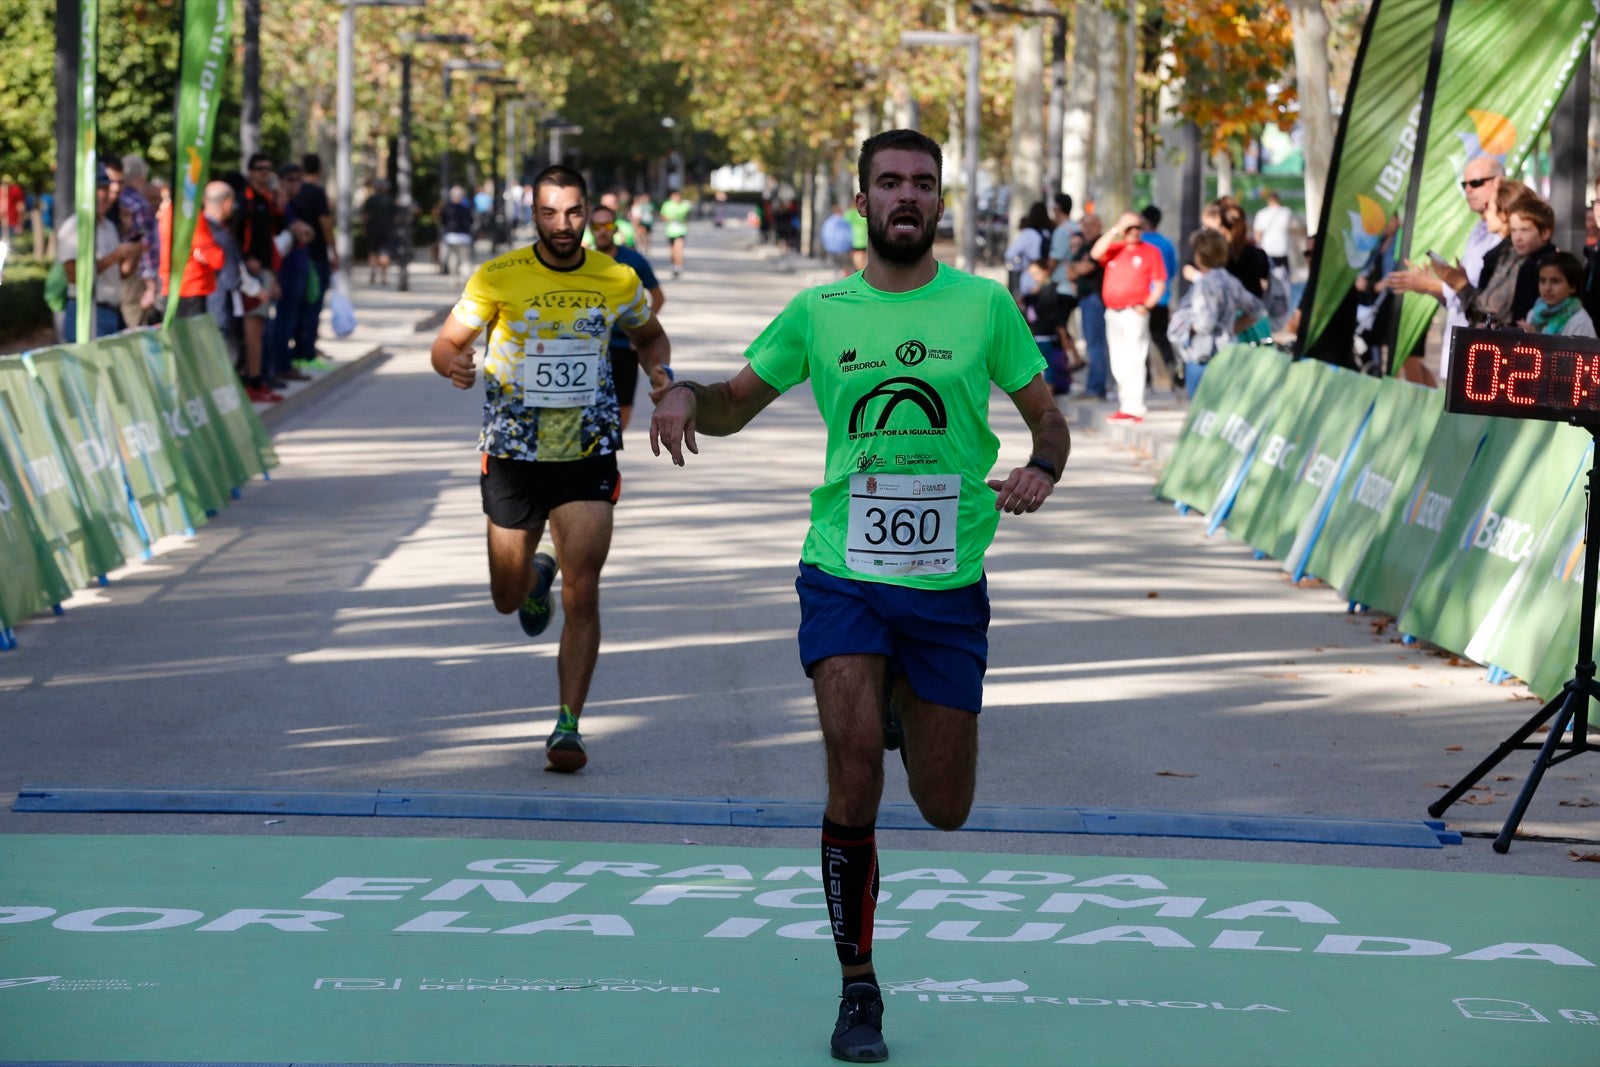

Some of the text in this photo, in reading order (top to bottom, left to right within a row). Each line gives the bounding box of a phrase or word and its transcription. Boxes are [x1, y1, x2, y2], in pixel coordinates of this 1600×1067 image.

[536, 361, 587, 388] 532
[841, 360, 887, 373] IBERDROLA
[849, 433, 857, 441] EN
[864, 507, 941, 546] 360
[300, 877, 1341, 924] EN FORMA
[391, 910, 635, 936] LA
[593, 985, 721, 994] JOVEN
[917, 993, 1291, 1013] IBERDROLA
